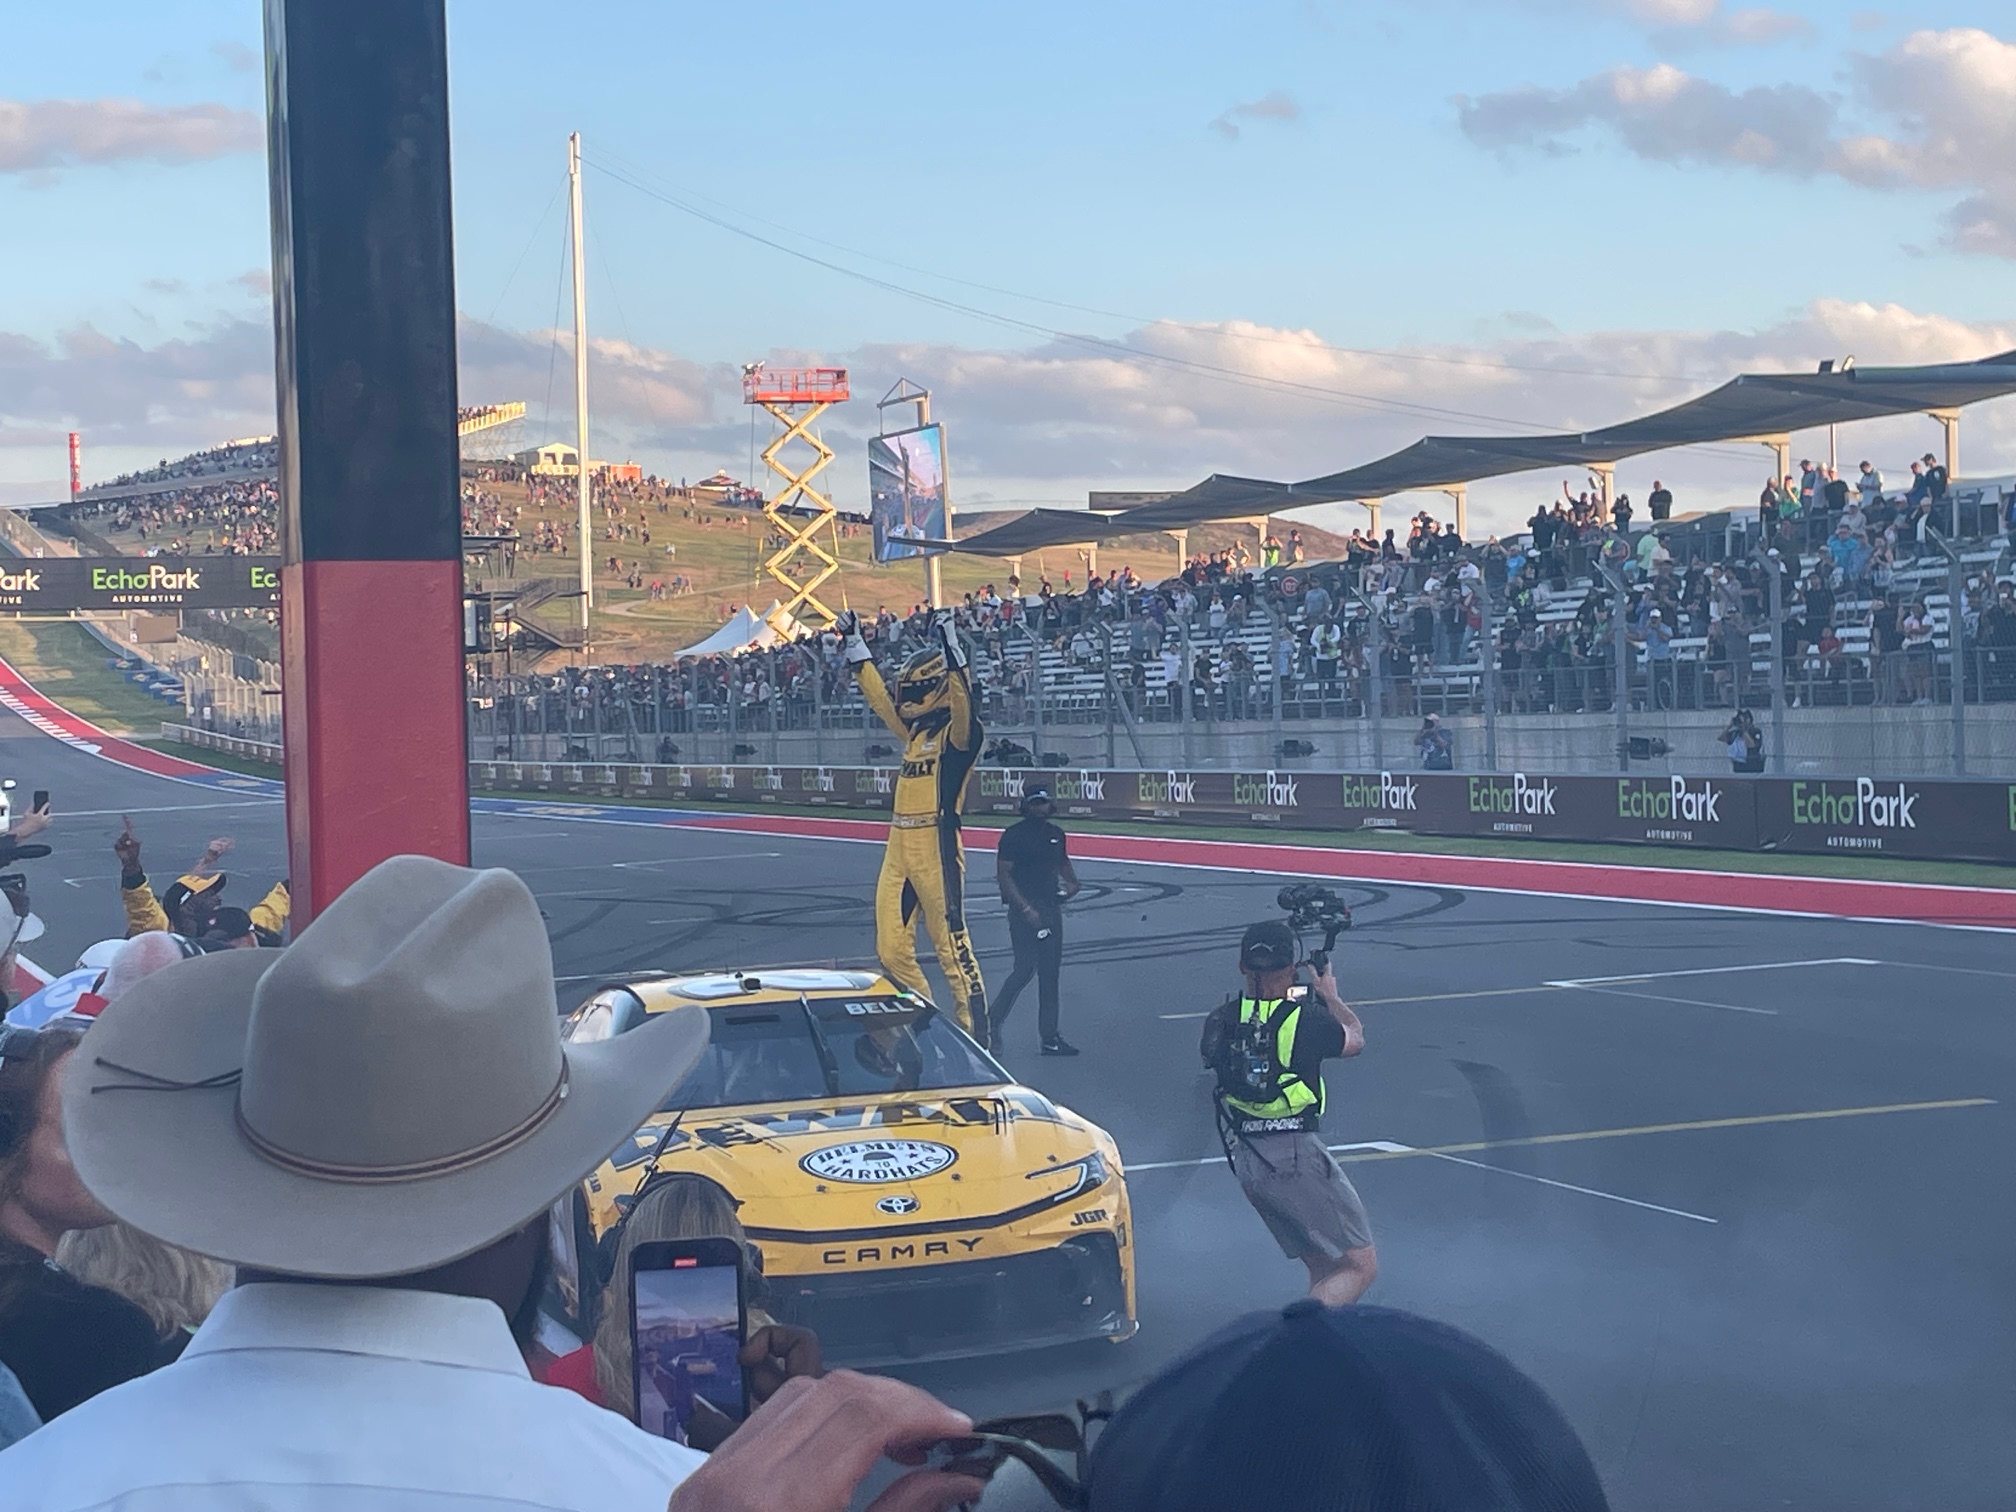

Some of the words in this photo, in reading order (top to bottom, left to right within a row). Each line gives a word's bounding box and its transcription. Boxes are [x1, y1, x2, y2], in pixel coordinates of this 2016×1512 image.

[92, 565, 200, 590] EchoPark
[112, 595, 183, 603] AUTOMOTIVE
[1138, 770, 1196, 802] EchoPark
[1234, 770, 1298, 806] EchoPark
[1343, 771, 1417, 810] EchoPark
[1469, 773, 1556, 815] EchoPark
[1618, 775, 1720, 822] EchoPark
[1793, 777, 1916, 828] EchoPark
[1827, 836, 1882, 849] AUTOMOTIVE
[844, 1001, 914, 1015] BELL
[823, 1156, 943, 1179] HARDHATS
[1070, 1208, 1109, 1226] JGR
[823, 1236, 984, 1264] CAMRY
